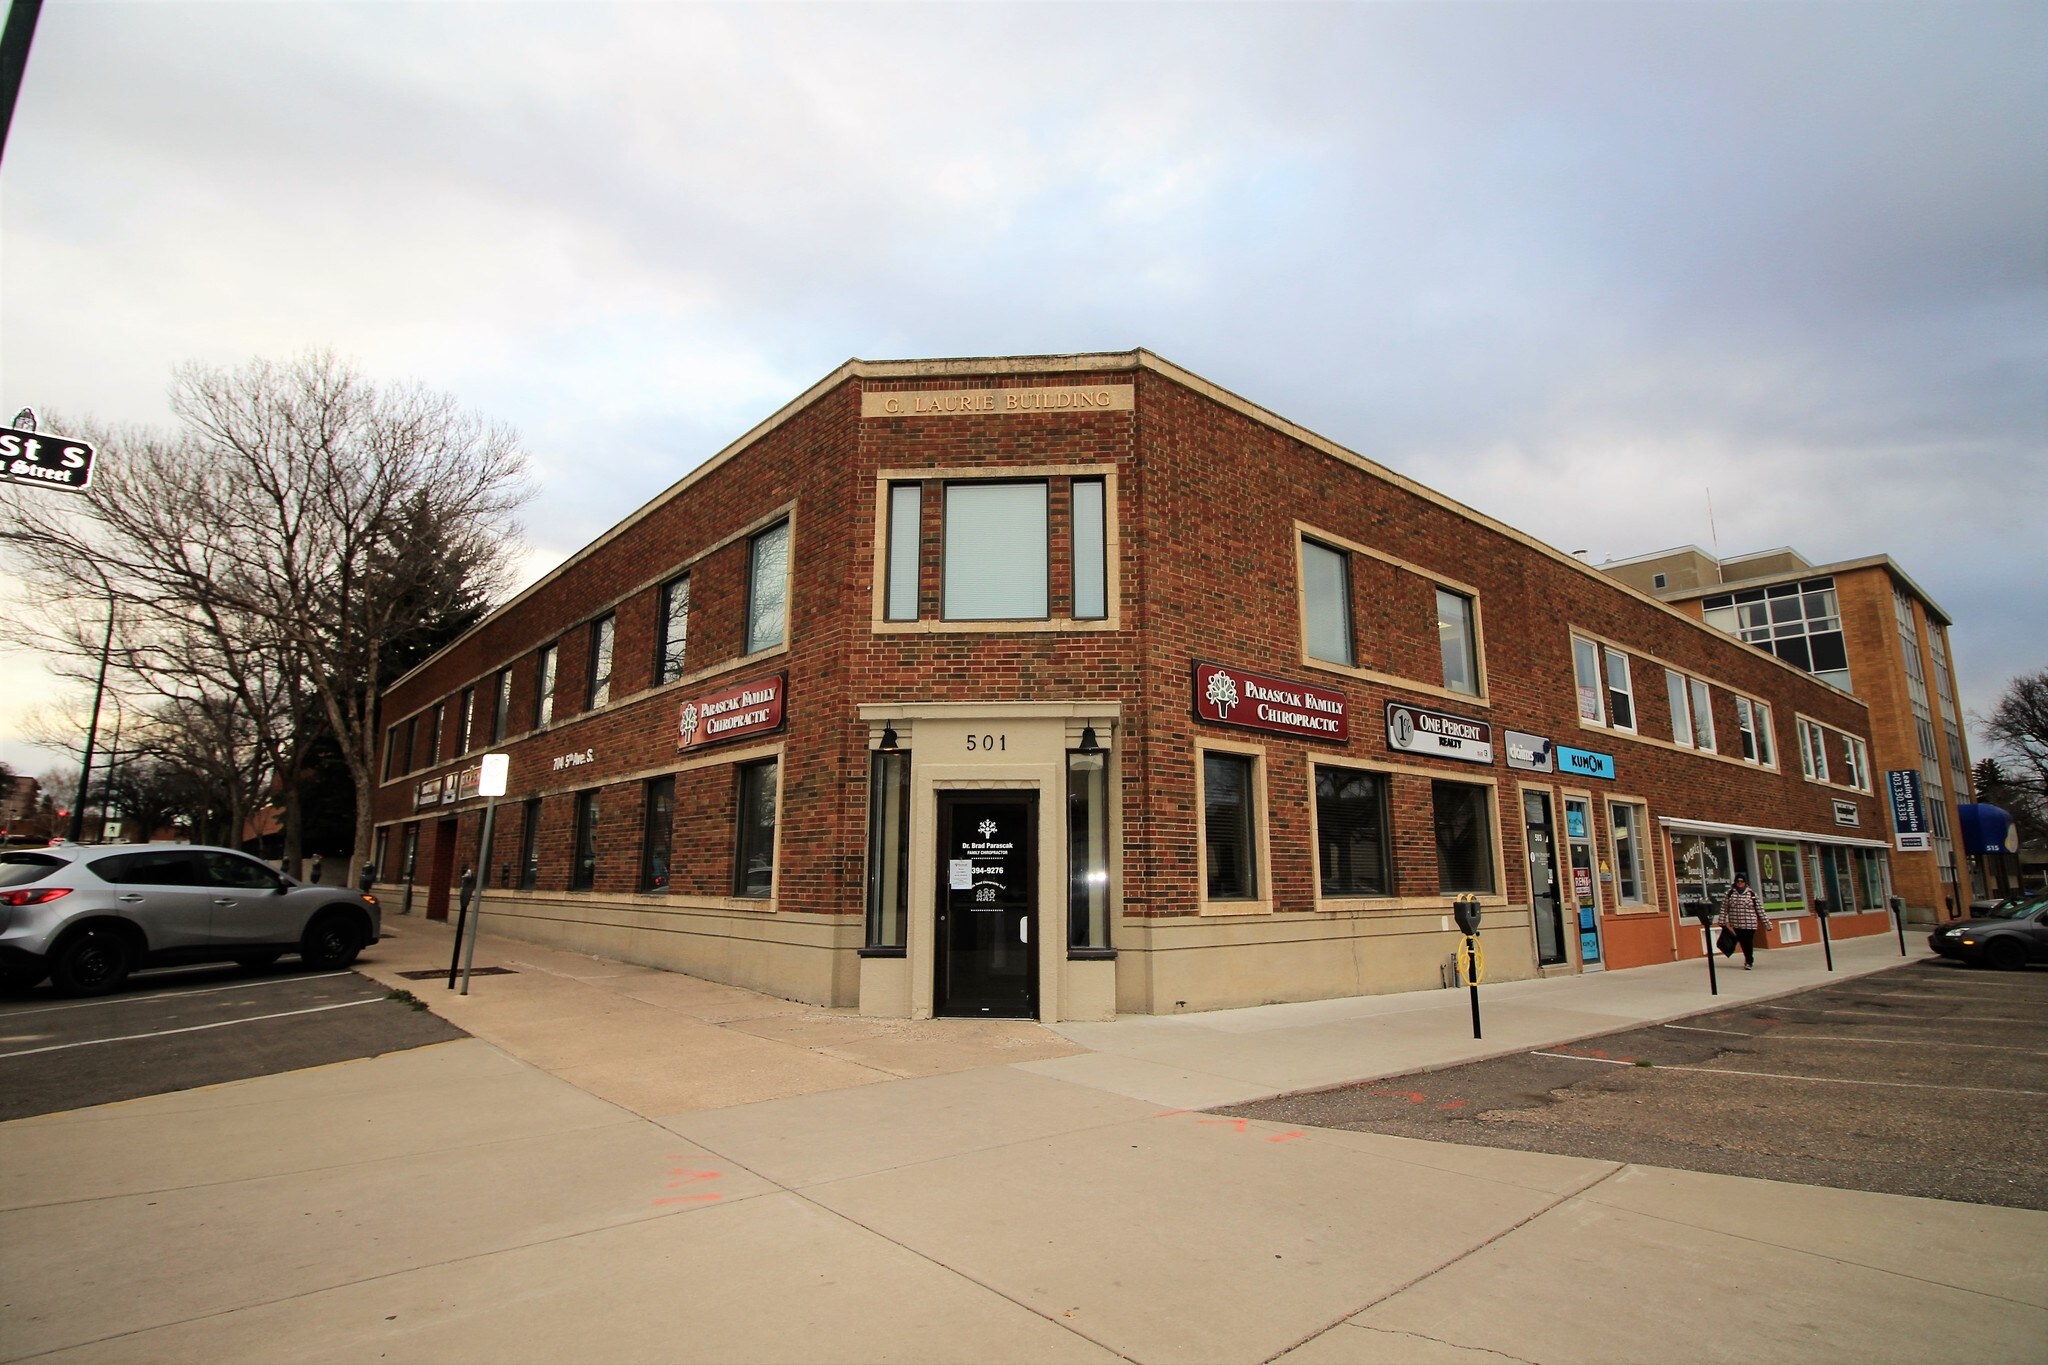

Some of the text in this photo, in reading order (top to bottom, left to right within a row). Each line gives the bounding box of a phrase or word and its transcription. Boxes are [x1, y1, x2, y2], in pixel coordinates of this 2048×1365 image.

[884, 391, 1111, 414] G. LAURIE BUILDING
[0, 435, 85, 468] St S
[742, 686, 777, 707] FAMILY
[1244, 680, 1344, 715] PARASCAK FAMILY
[706, 708, 770, 734] CHIROPRACTIC
[1257, 703, 1339, 733] CHIROPRACTIC
[1419, 714, 1480, 741] ONE PERCENT
[966, 734, 1006, 751] 501
[1438, 736, 1462, 749] REALTY
[1571, 754, 1603, 773] KUMON
[1902, 771, 1913, 799] Leasing
[1906, 799, 1919, 832] Inquiries
[971, 867, 1004, 875] 394-9276
